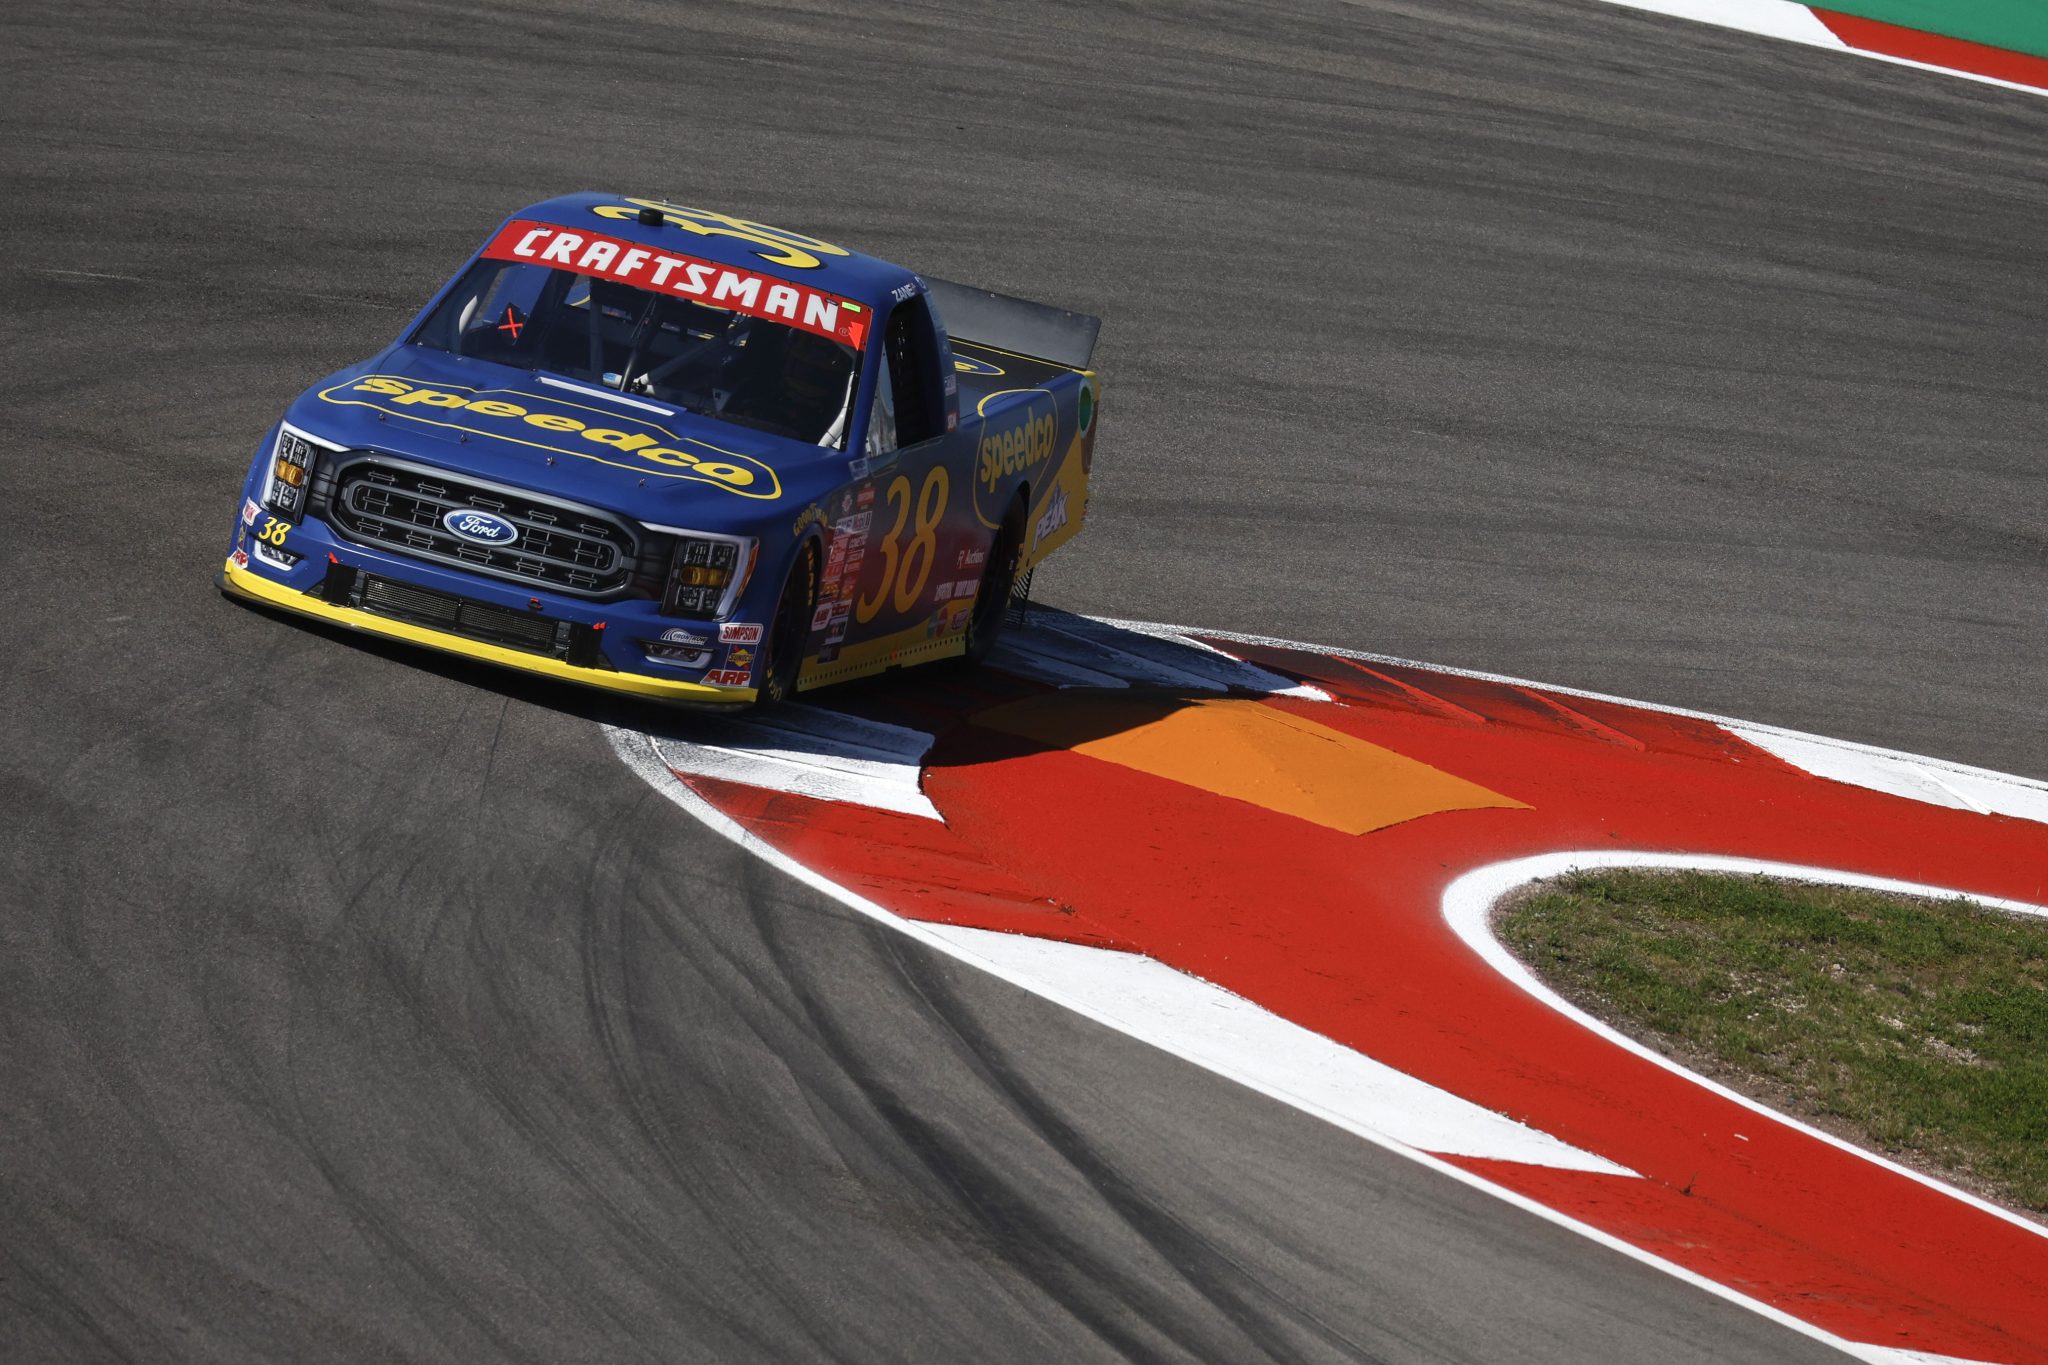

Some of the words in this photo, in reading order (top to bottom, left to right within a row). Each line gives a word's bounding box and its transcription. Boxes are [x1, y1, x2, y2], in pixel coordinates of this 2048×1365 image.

[513, 230, 839, 333] CRAFTSMAN
[891, 283, 915, 302] ZANE
[352, 377, 755, 487] speedco
[980, 406, 1054, 494] speedco
[258, 516, 292, 546] 38
[459, 515, 501, 538] Ford
[856, 465, 950, 624] 38
[1032, 491, 1070, 553] PEAK
[723, 626, 759, 641] SIMPSON
[704, 670, 750, 686] ARP
